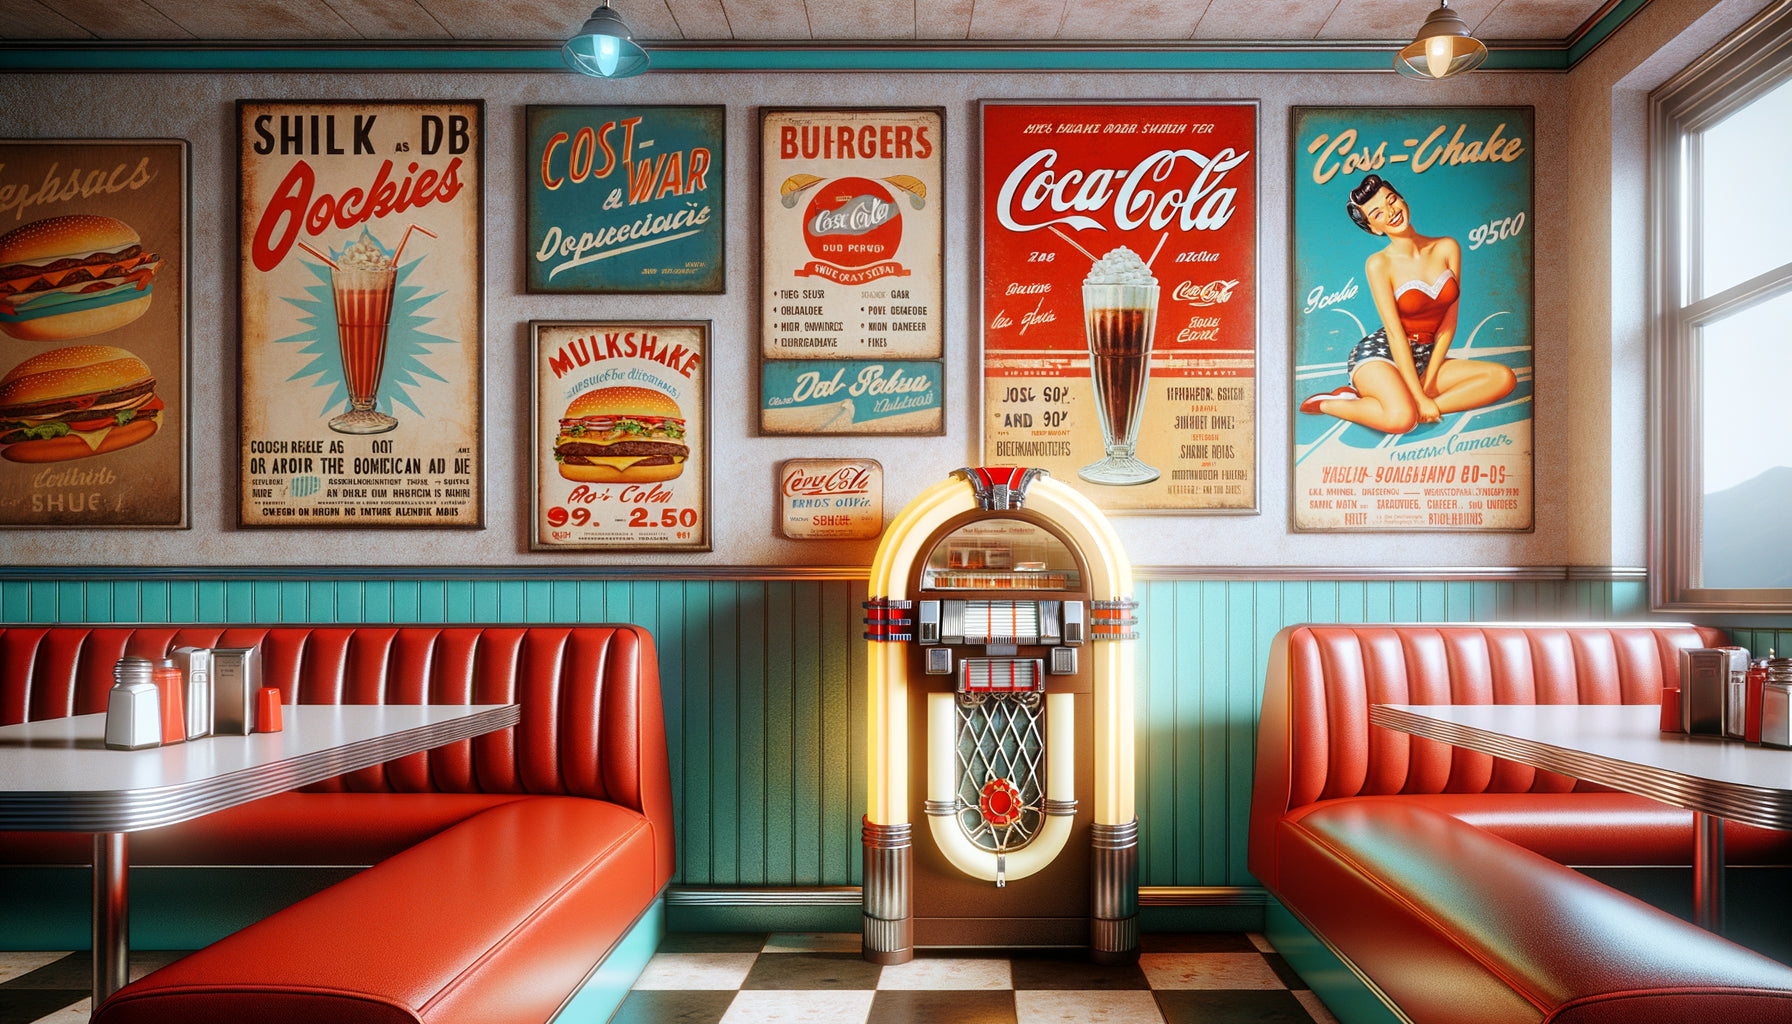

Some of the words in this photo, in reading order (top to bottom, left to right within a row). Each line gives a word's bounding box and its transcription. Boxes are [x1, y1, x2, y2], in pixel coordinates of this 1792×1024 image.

[253, 114, 377, 155] SHILK
[395, 142, 410, 152] AS
[421, 115, 470, 155] DB
[623, 147, 711, 206] WAR
[997, 148, 1251, 233] Coca-Cola
[548, 332, 701, 380] MULKSHAKE
[1004, 413, 1033, 428] AND
[250, 457, 266, 475] OR
[320, 457, 345, 475] THE
[628, 507, 698, 528] 2.50
